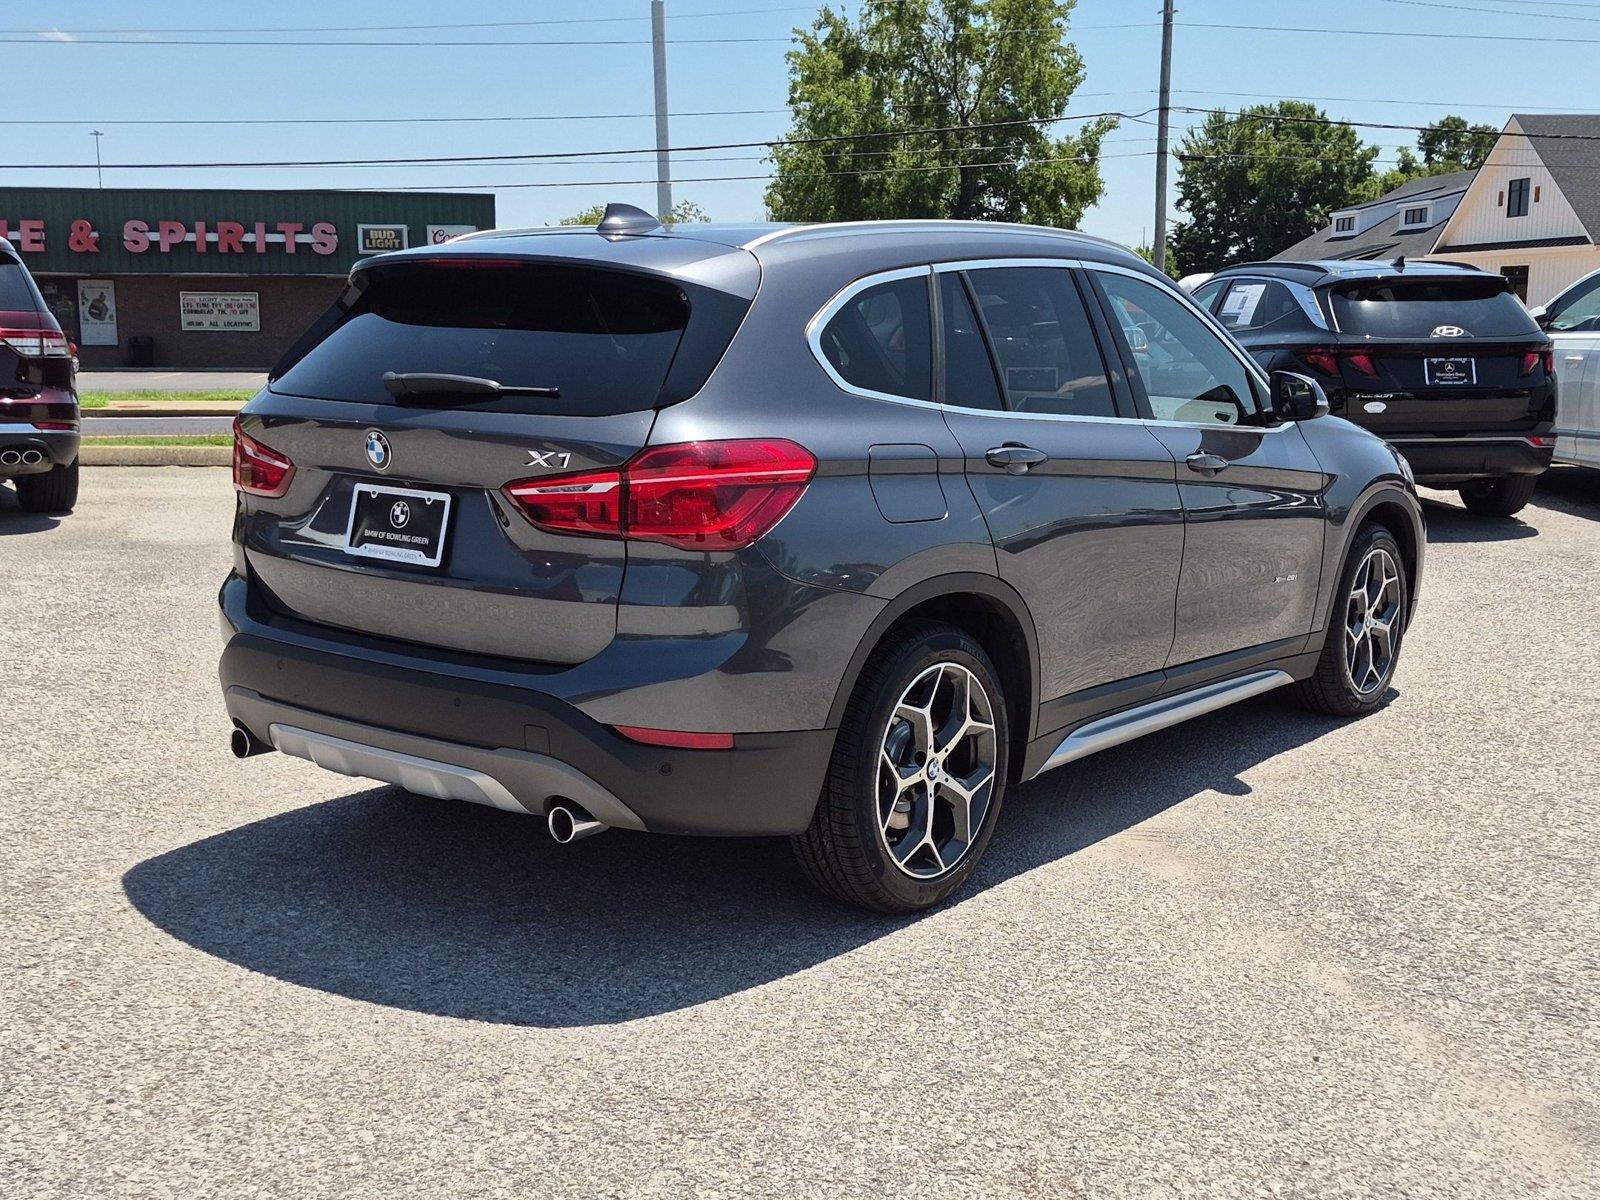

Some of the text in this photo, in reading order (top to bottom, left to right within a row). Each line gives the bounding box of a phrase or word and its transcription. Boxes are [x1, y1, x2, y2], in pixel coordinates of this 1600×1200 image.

[0, 219, 339, 255] E & SPIRITS
[370, 230, 395, 239] BUD
[365, 239, 401, 248] LIGHT
[521, 449, 571, 469] X1
[364, 529, 430, 545] BMW OF BOWLING GREEN
